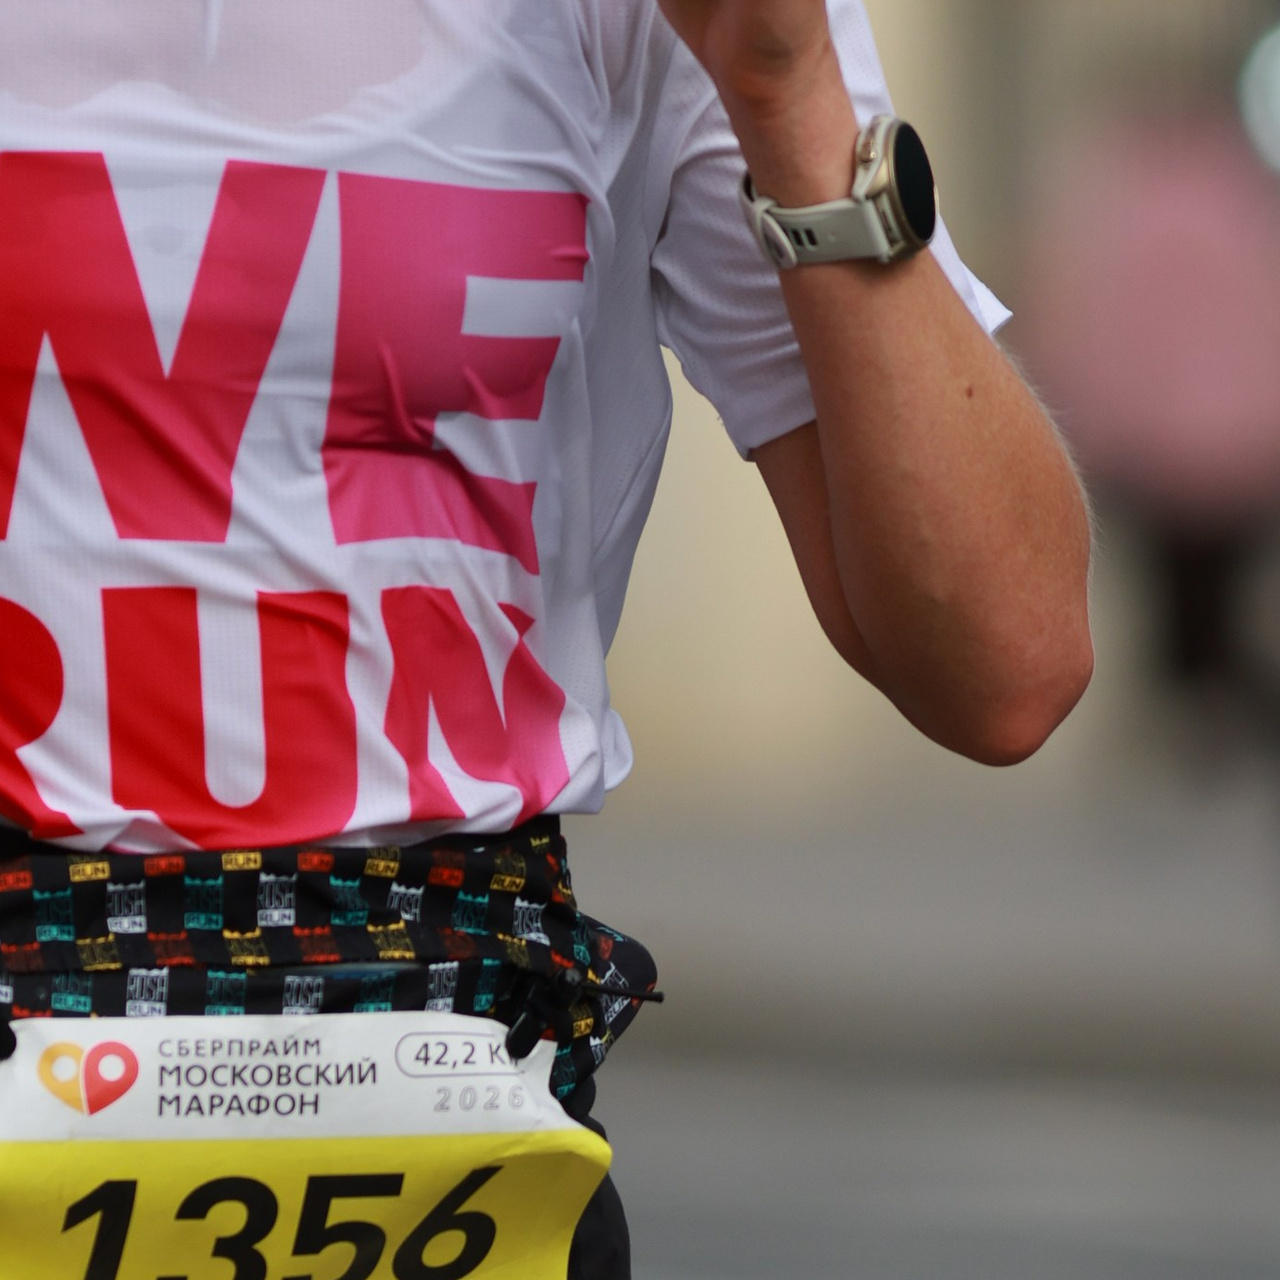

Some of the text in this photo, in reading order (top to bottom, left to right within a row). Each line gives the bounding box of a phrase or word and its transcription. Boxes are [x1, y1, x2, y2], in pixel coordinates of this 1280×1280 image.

[147, 858, 183, 873] RUN
[222, 854, 259, 869] RUN
[299, 855, 333, 870] RUN
[366, 860, 398, 875] RUN
[71, 863, 108, 879] RUN
[431, 869, 462, 884] RUN
[492, 875, 523, 890] RUN
[158, 1036, 321, 1058] СБЕРПРАЙМ
[414, 1041, 519, 1069] 42,2 К
[158, 1057, 378, 1087] МОСКОВСКИЙ
[158, 1093, 321, 1117] МАРАФОН
